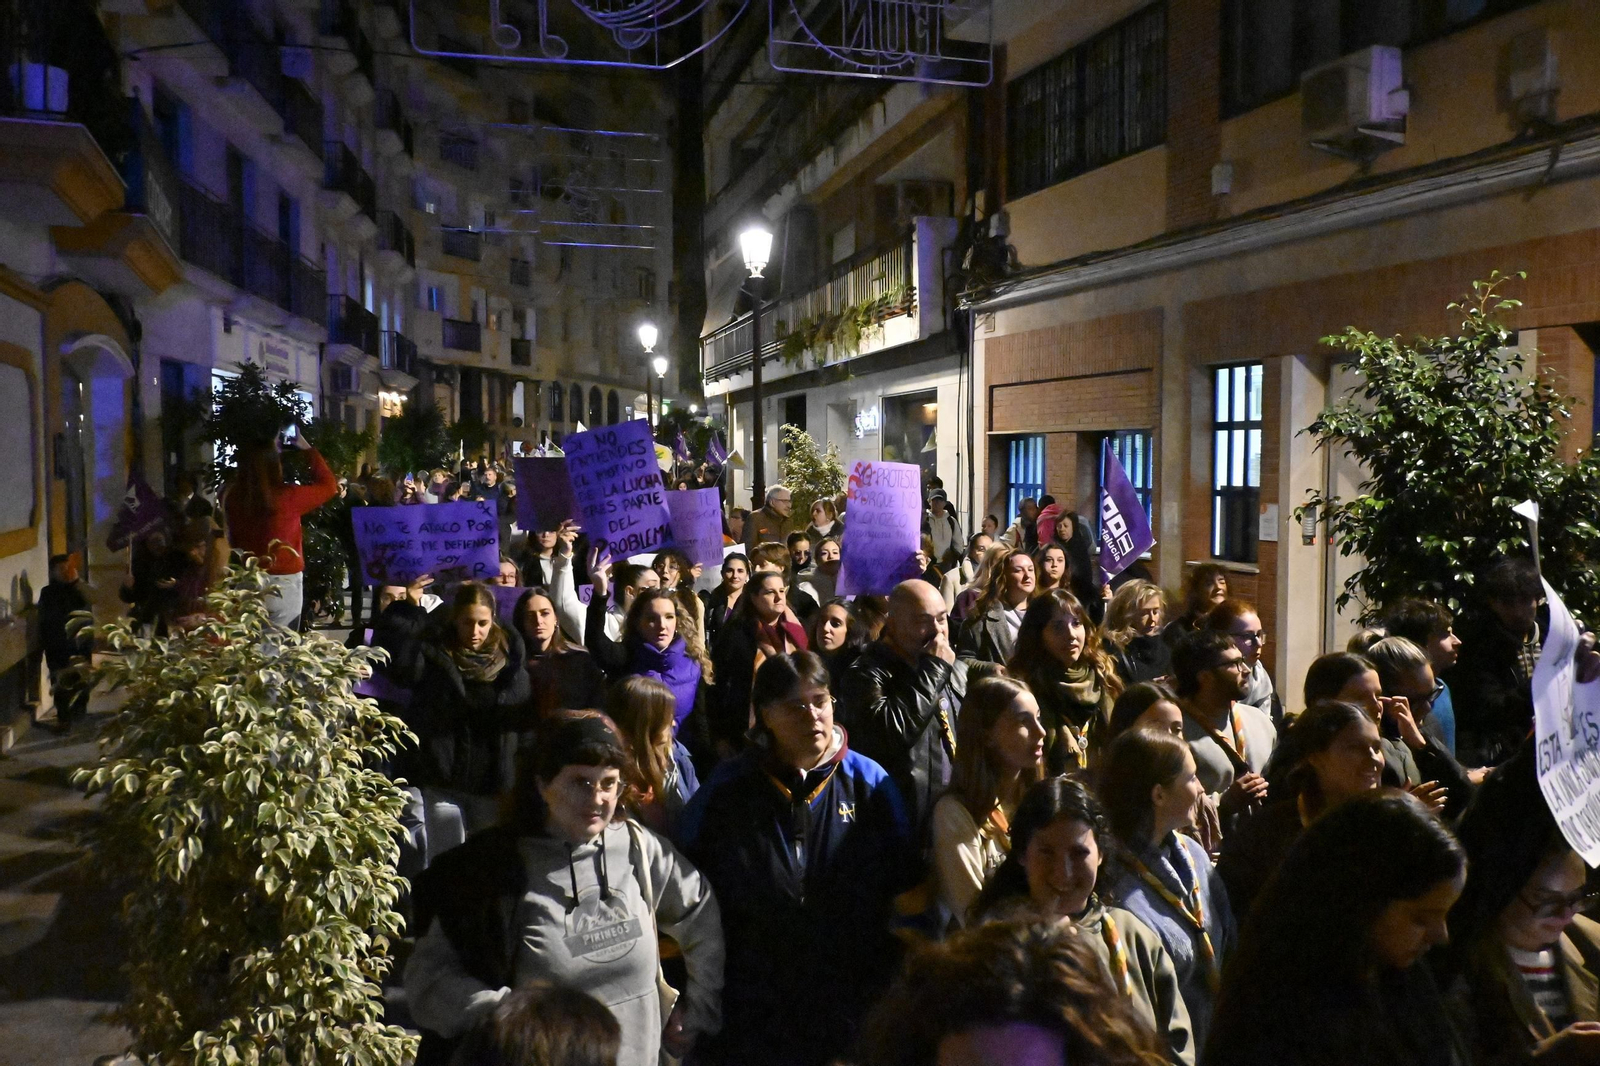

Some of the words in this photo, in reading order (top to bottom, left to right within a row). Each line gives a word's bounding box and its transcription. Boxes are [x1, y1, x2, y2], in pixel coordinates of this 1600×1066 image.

[565, 436, 582, 455] SI
[594, 430, 617, 448] NO
[570, 439, 647, 472] ENTIENDES
[574, 474, 589, 488] EL
[595, 458, 647, 481] MOTIVO
[876, 467, 919, 489] PROTESTO
[578, 490, 594, 502] DE
[603, 483, 618, 497] LA
[622, 472, 662, 494] LUCHA
[853, 489, 895, 509] PORQUE
[902, 491, 919, 510] NO
[583, 500, 617, 517] ERES
[622, 491, 664, 512] PARTE
[364, 521, 386, 536] NO
[418, 521, 461, 534] ATACO
[467, 519, 493, 532] POR
[608, 515, 640, 534] DEL
[853, 511, 908, 529] CONOZCO
[371, 538, 414, 551] HOMBRE
[422, 540, 438, 551] ME
[444, 537, 496, 550] DEFIENDO
[595, 522, 674, 556] PROBLEMA
[436, 555, 462, 566] SOY
[1538, 730, 1563, 777] ESTA
[1543, 779, 1566, 813] LA
[1561, 815, 1593, 853] QUE
[582, 922, 631, 945] PIRINEOS
